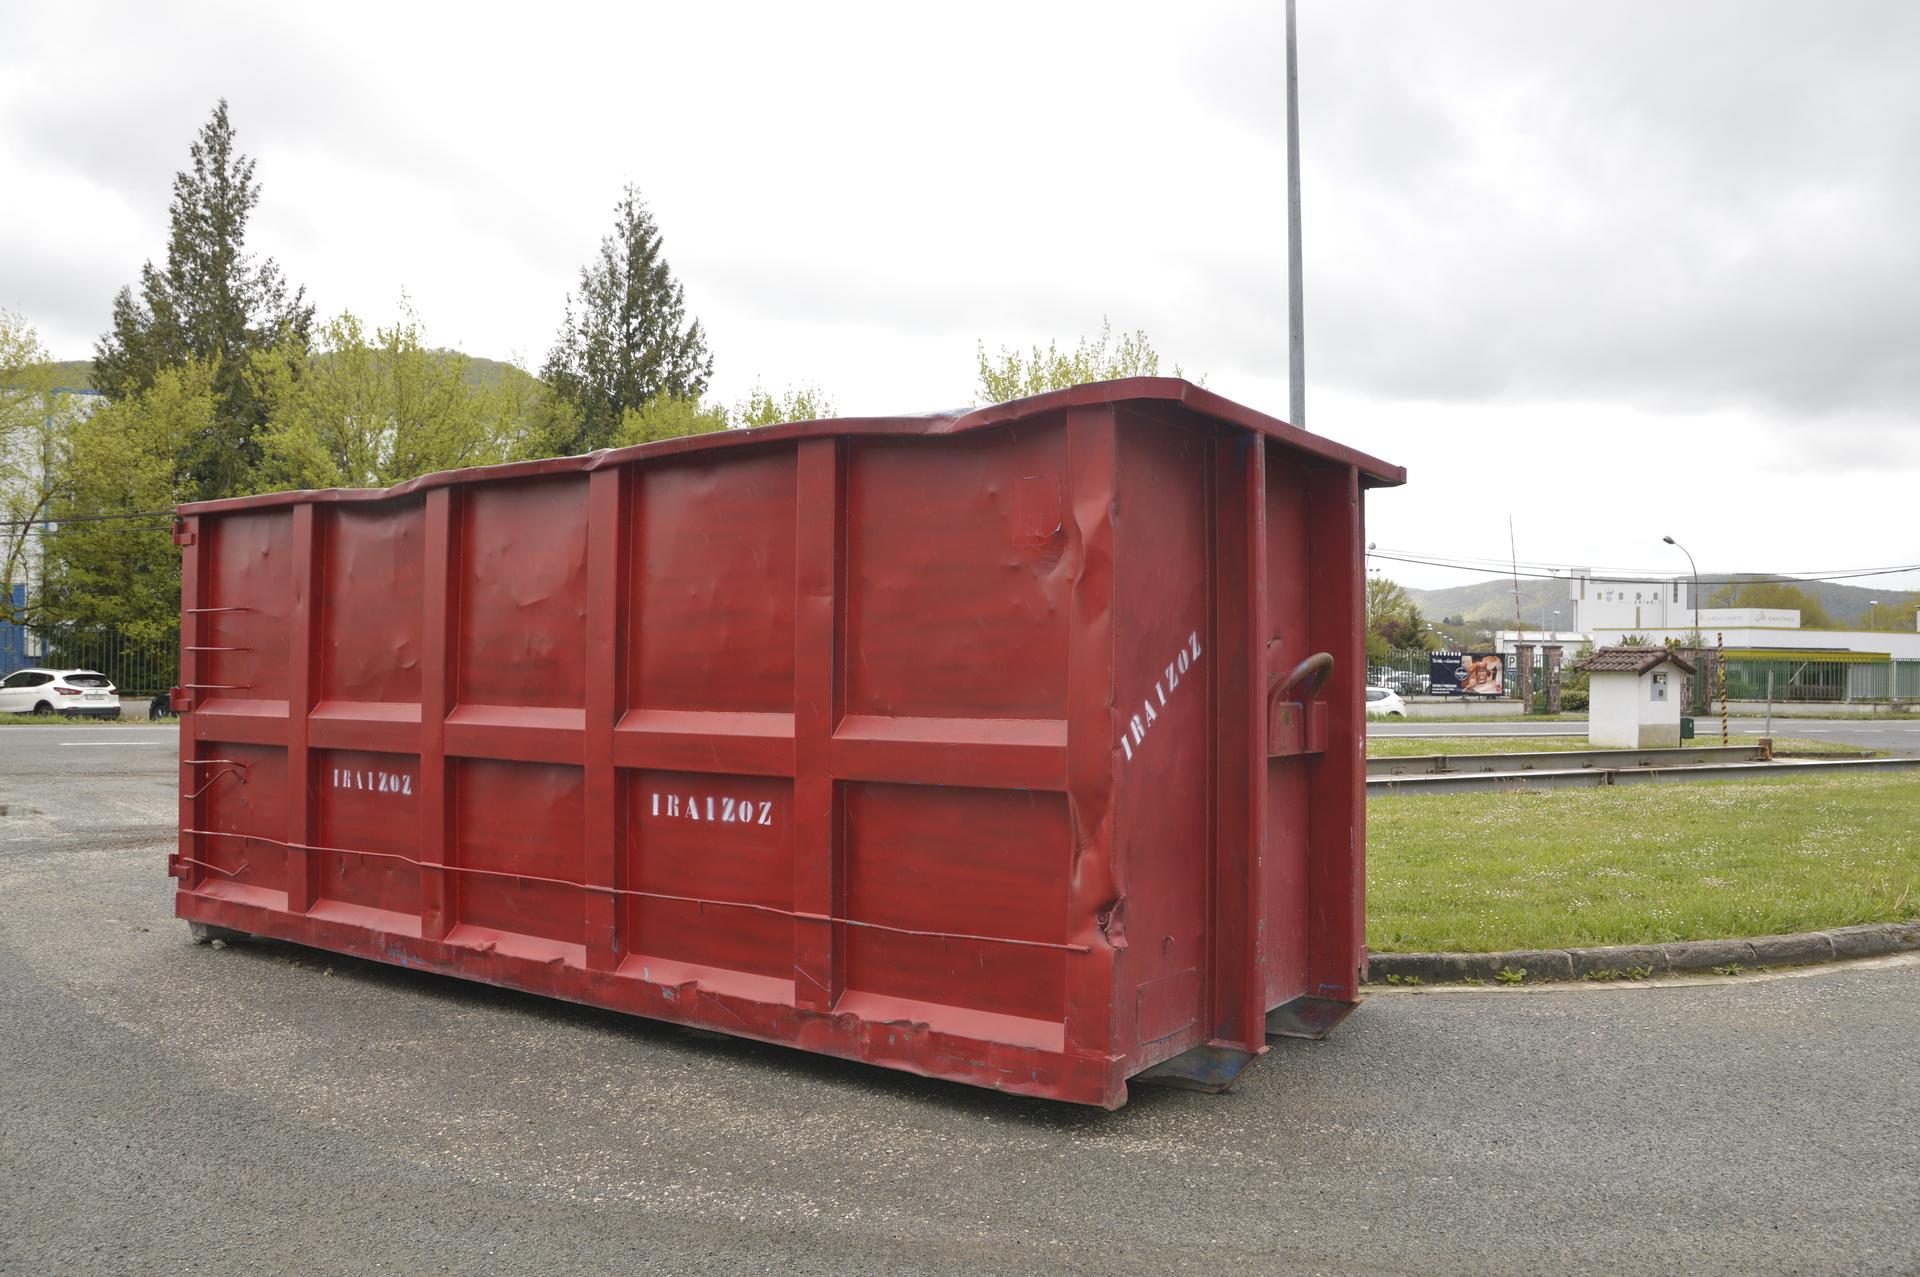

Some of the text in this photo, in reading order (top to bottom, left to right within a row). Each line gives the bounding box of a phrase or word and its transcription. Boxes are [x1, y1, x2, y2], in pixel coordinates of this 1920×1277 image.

[1509, 656, 1515, 667] P
[1121, 630, 1202, 761] IRAIZOZ
[334, 769, 412, 795] IRAIZOZ
[652, 793, 772, 825] IRAIZOZ
